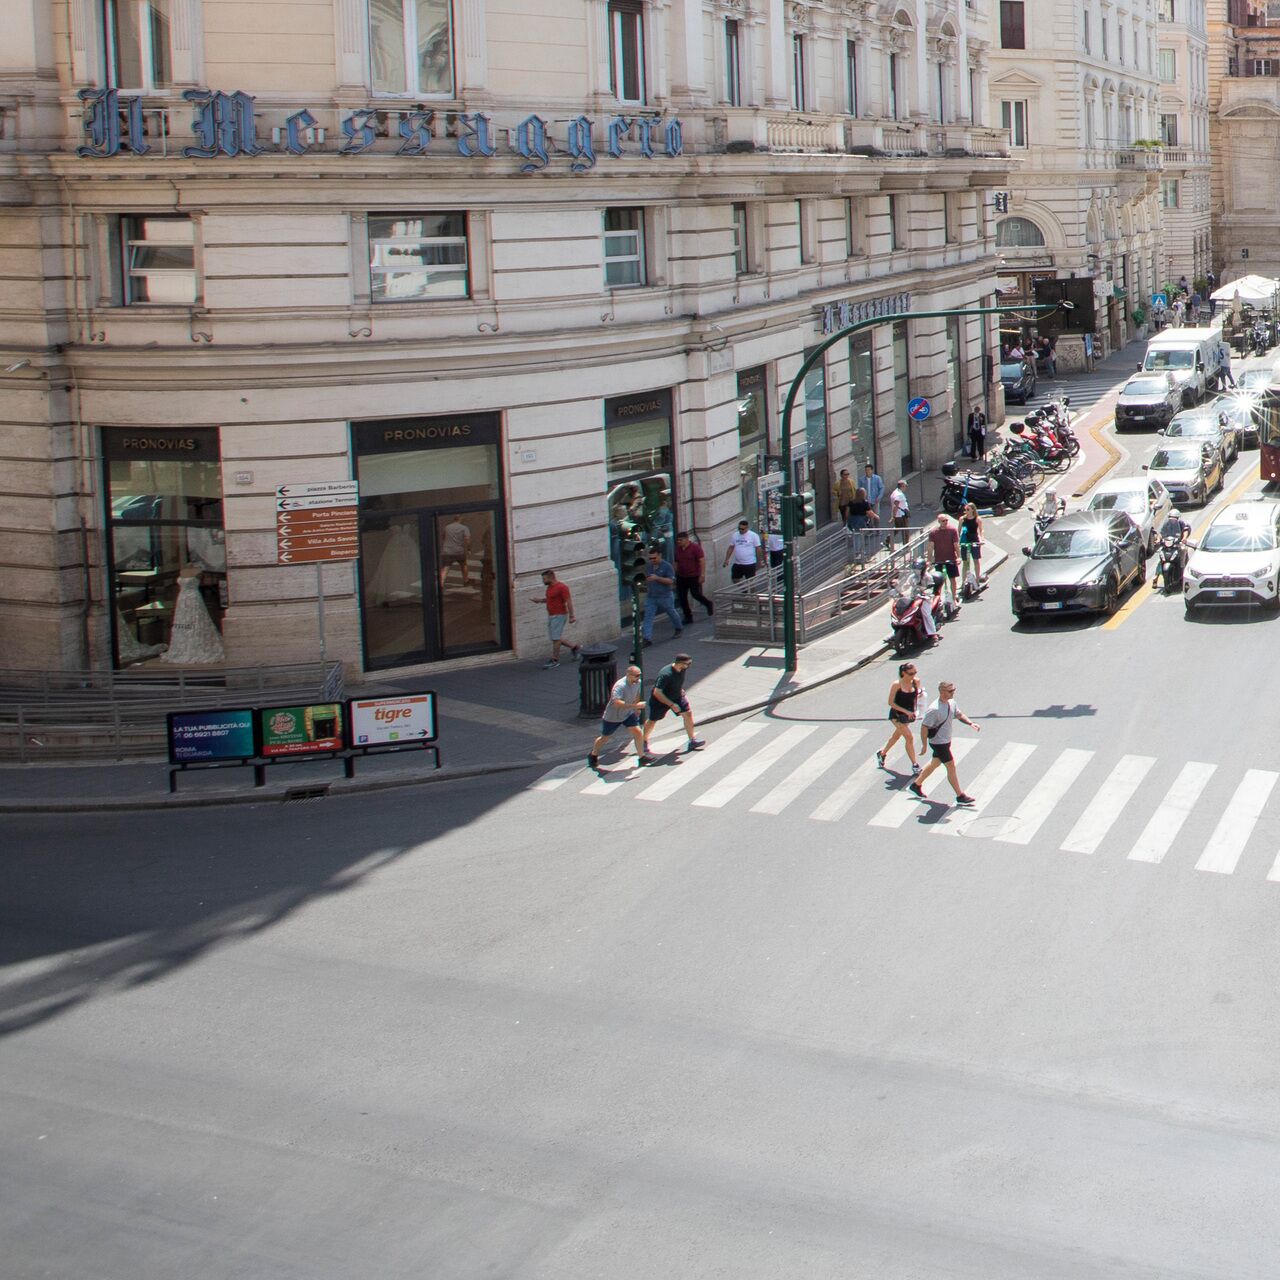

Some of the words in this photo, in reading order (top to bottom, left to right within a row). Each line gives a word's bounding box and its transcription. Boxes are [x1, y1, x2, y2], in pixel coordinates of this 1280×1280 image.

[77, 88, 151, 158] Il
[182, 90, 684, 172] Messaggero
[617, 400, 662, 416] PRONOVIAS
[384, 424, 472, 441] PRONOVIAS
[122, 438, 196, 450] PRONOVIAS
[375, 708, 412, 723] tigre
